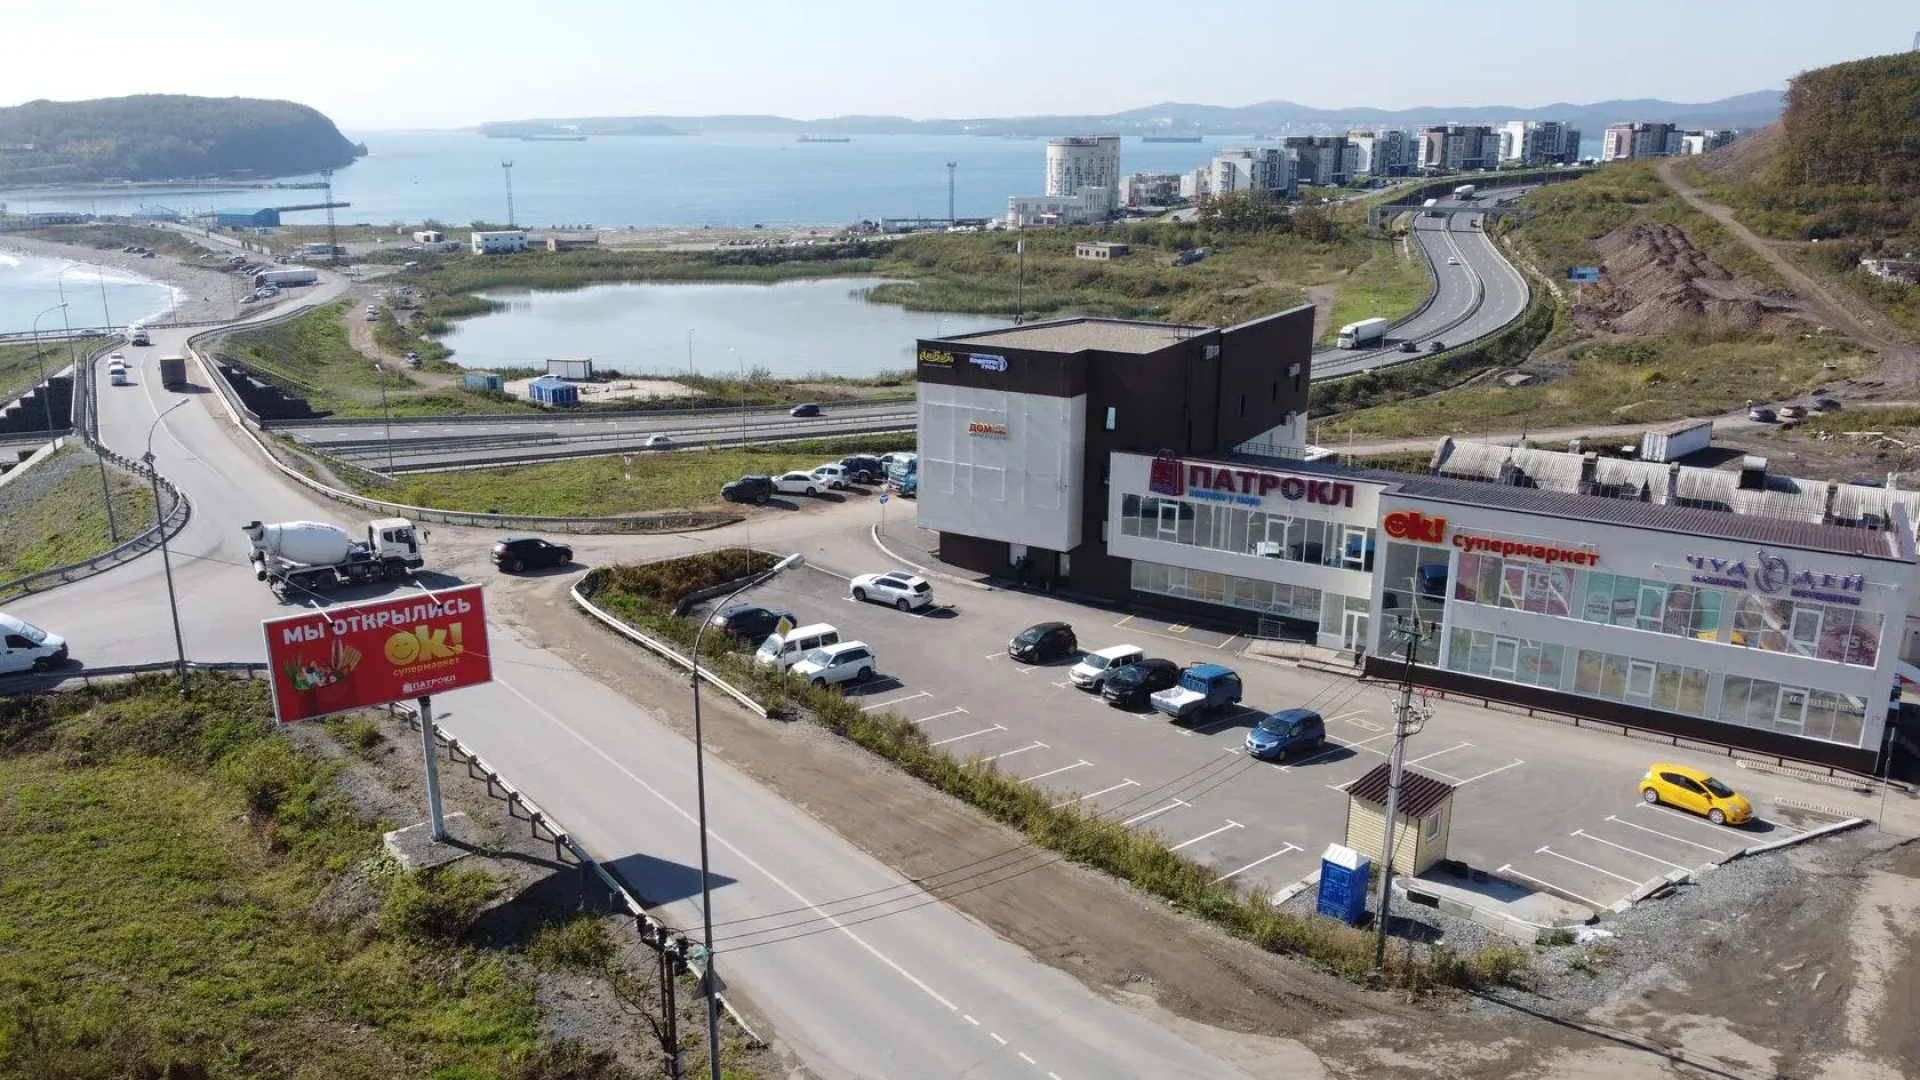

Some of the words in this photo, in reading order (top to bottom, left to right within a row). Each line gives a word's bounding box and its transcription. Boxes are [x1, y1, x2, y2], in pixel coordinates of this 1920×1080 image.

[969, 423, 992, 433] ДОМ
[1189, 465, 1355, 508] ПАТРОКЛ
[1452, 533, 1601, 567] супермаркет
[283, 622, 325, 645] МЫ
[333, 598, 472, 636] ОТКРЫЛИСЬ
[393, 657, 460, 677] супермаркет
[413, 675, 456, 689] ПАТРОКЛ
